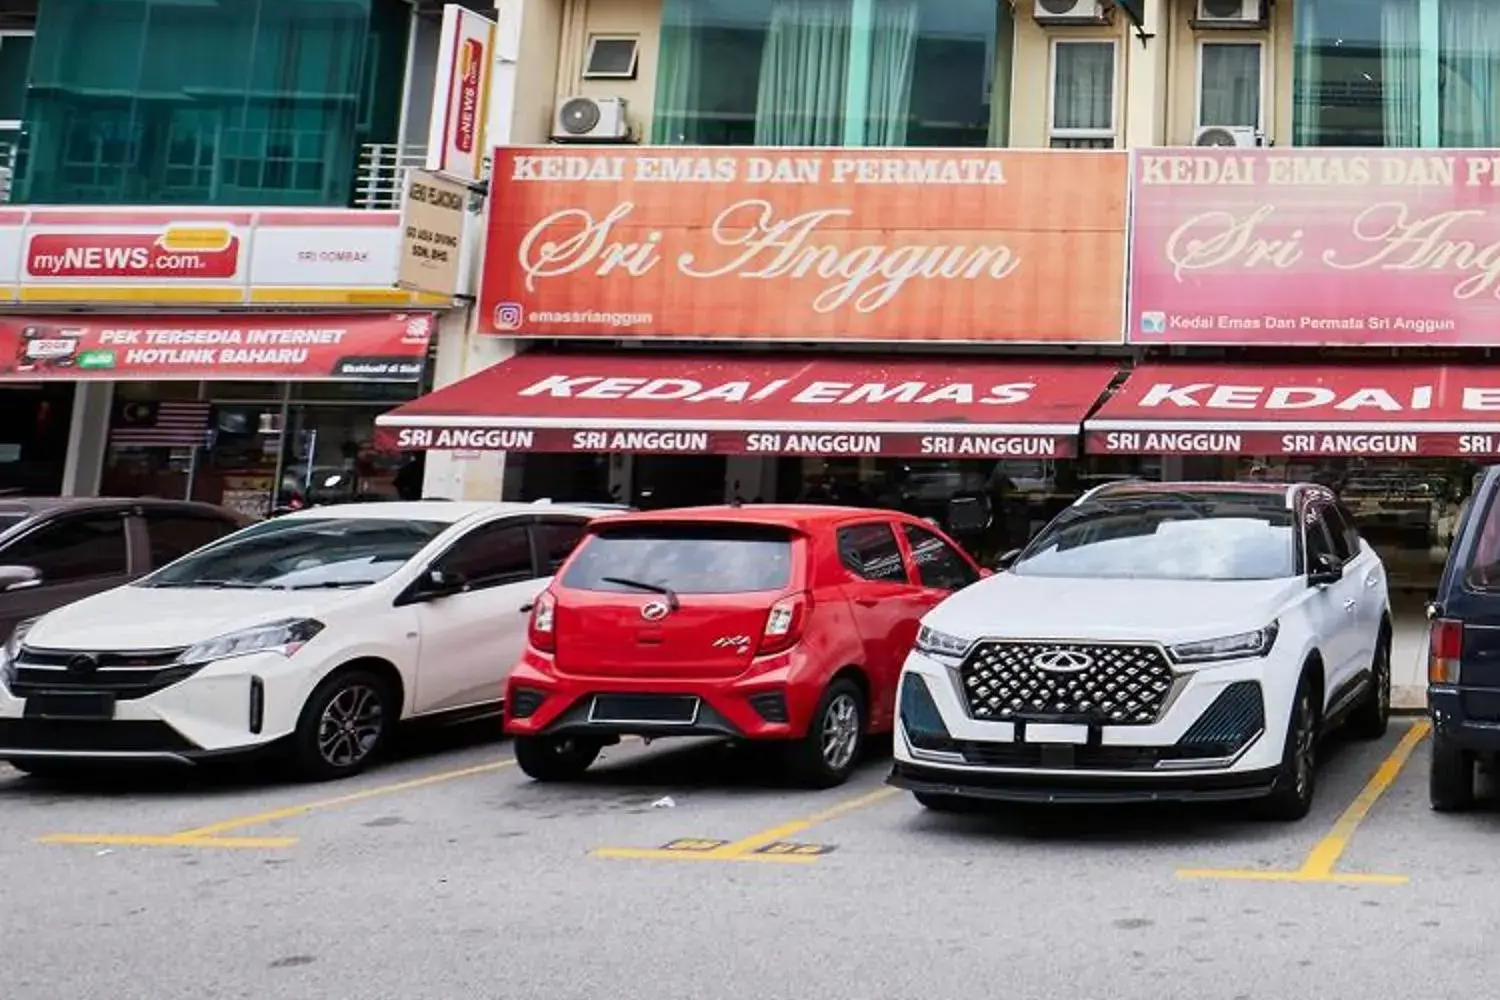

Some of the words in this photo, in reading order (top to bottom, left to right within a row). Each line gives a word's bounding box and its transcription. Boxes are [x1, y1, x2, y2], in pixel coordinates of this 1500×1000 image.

[512, 155, 625, 181] KEDAI
[633, 156, 737, 182] EMAS
[746, 157, 822, 183] DAN
[830, 158, 1007, 185] PERMATA
[1140, 155, 1256, 185] KEDAI
[1266, 156, 1370, 185] EMAS
[1381, 157, 1455, 186] DAN
[1165, 202, 1303, 283] Sri
[518, 201, 663, 292] Sri
[677, 199, 1021, 314] Anggun
[1169, 314, 1214, 330] Kedai
[1217, 315, 1261, 330] Emas
[1264, 316, 1296, 330] Dan
[1299, 316, 1364, 331] Permata
[1367, 316, 1390, 331] Sri
[1392, 316, 1455, 334] Anggun
[99, 329, 143, 344] PEK
[145, 329, 241, 344] TERSEDIA
[245, 329, 347, 344] INTERNET
[125, 348, 215, 364] HOTLINK
[220, 348, 309, 364] BAHARU
[517, 375, 788, 402] KEDAI
[790, 380, 1037, 404] EMAS
[1138, 383, 1433, 411] KEDAI
[397, 429, 432, 448] SRI
[436, 429, 533, 448] ANGGUN
[572, 431, 604, 451] SRI
[609, 431, 709, 451] ANGGUN
[746, 434, 780, 453] SRI
[785, 434, 881, 453] ANGGUN
[920, 436, 954, 455] SRI
[959, 436, 1056, 455] ANGGUN
[1106, 433, 1139, 452] SRI
[1144, 433, 1241, 452] ANGGUN
[1281, 434, 1315, 453] SRI
[1320, 434, 1418, 453] ANGGUN
[1458, 435, 1492, 454] SRI
